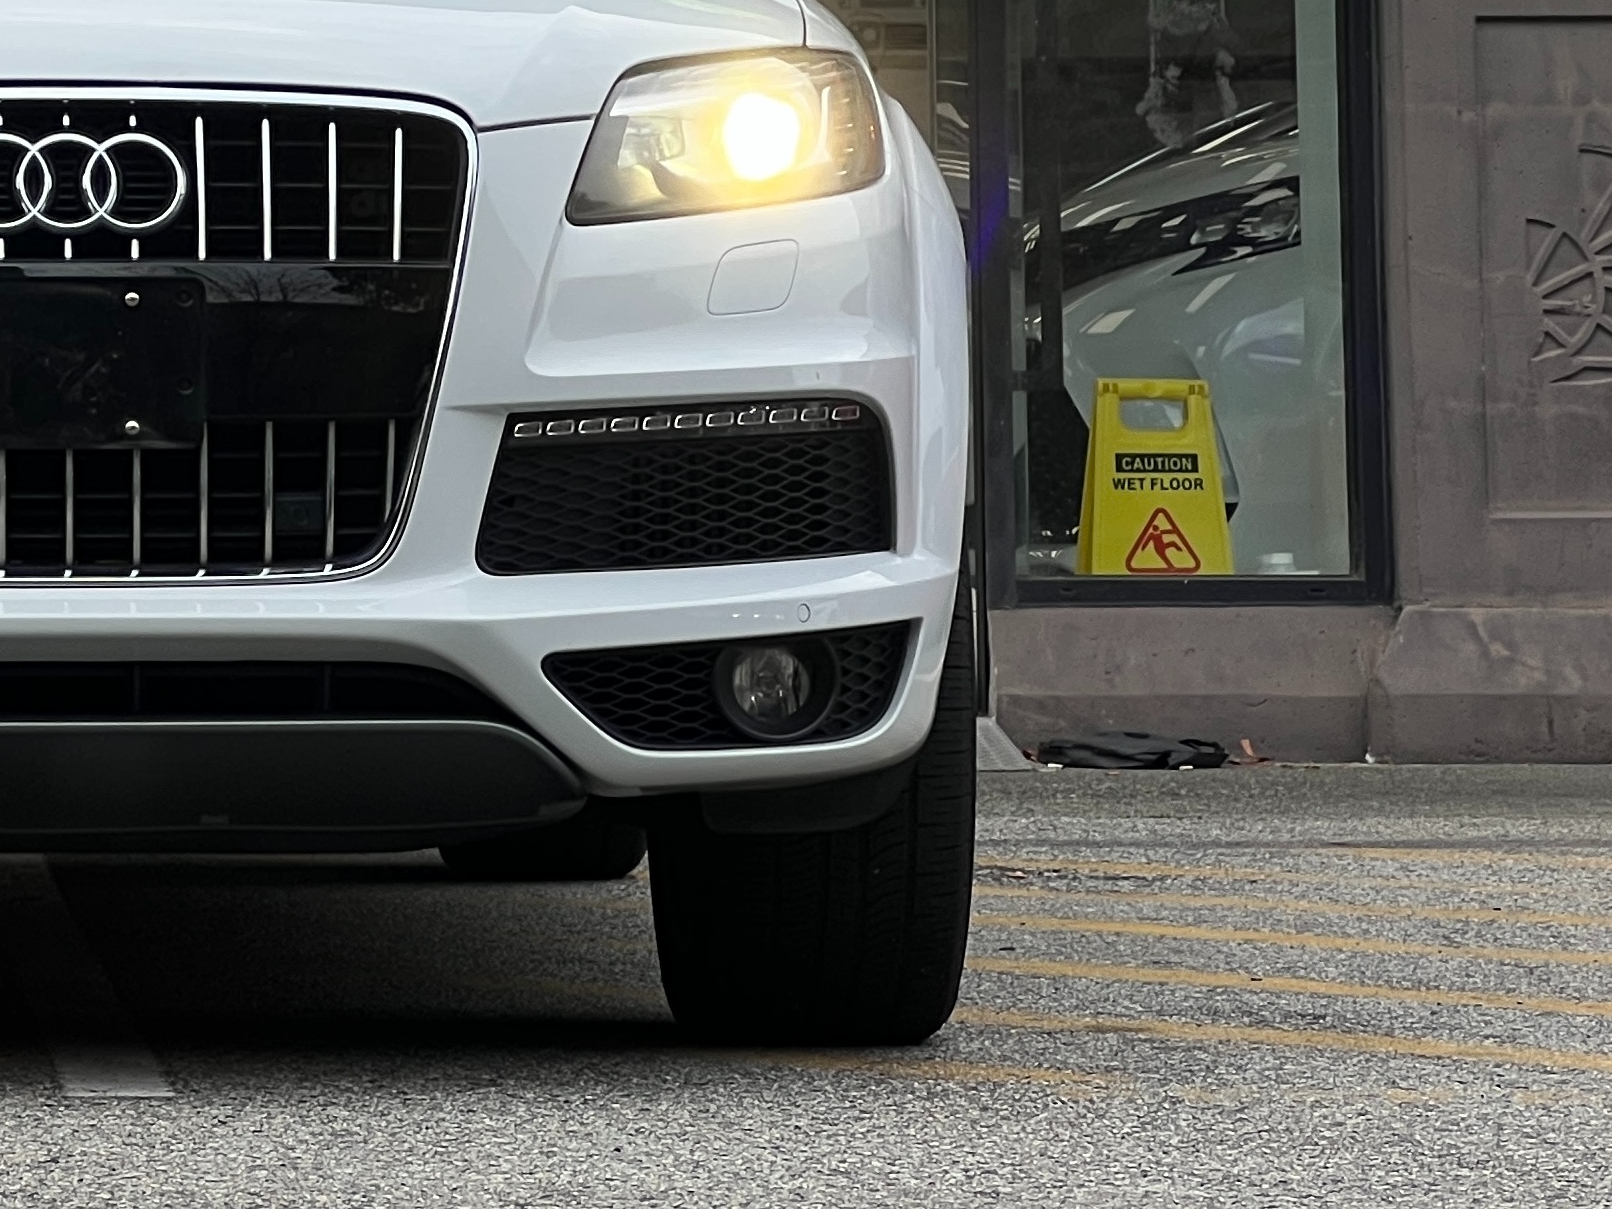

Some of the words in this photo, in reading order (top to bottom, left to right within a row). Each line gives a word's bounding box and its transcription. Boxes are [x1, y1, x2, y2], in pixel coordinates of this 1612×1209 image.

[1121, 457, 1193, 471] CAUTION
[1112, 477, 1146, 491] WET
[1150, 477, 1204, 491] FLOOR
